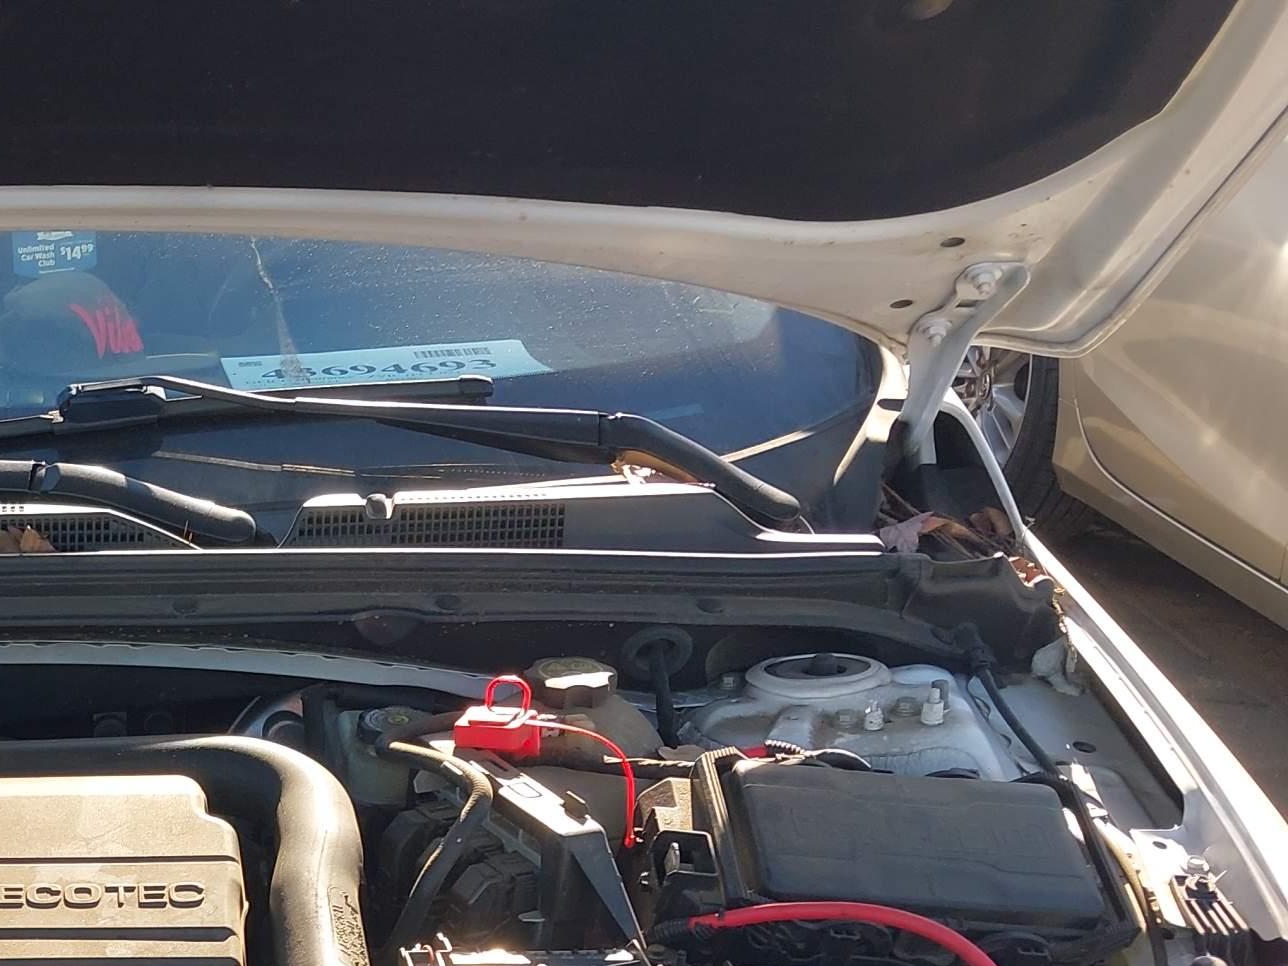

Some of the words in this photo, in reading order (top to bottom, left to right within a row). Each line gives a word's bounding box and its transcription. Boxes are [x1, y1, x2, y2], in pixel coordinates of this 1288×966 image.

[18, 243, 55, 255] Unlimited
[21, 254, 34, 262] Car
[33, 252, 55, 260] Wash
[38, 259, 55, 267] Club
